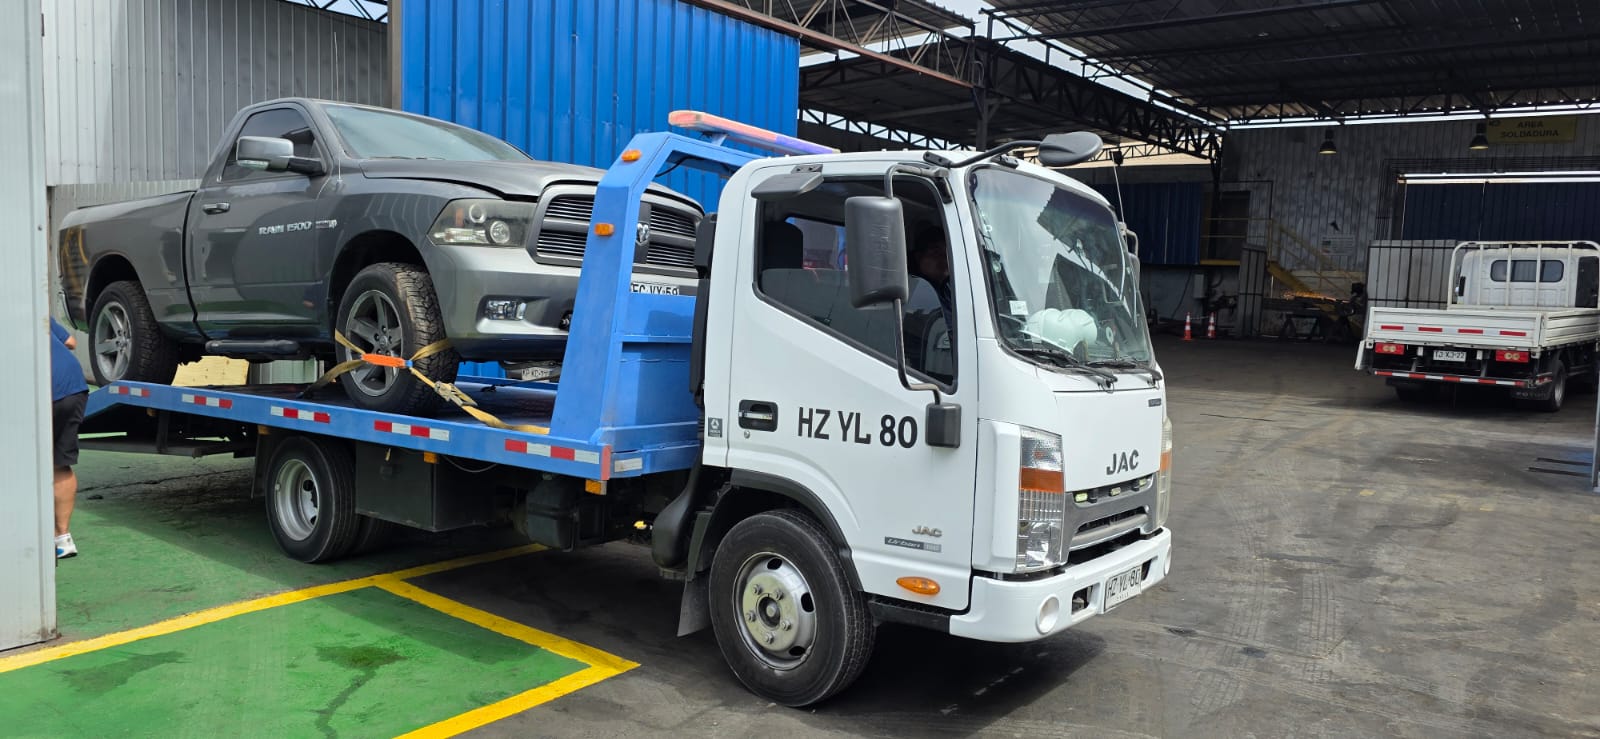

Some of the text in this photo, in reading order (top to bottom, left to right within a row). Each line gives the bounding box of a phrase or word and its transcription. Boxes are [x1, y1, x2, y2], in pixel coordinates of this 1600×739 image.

[259, 225, 284, 235] RAM
[287, 221, 312, 232] 1500
[798, 406, 918, 449] HZ YL 80
[1106, 449, 1139, 475] JAC
[911, 525, 942, 537] JAC
